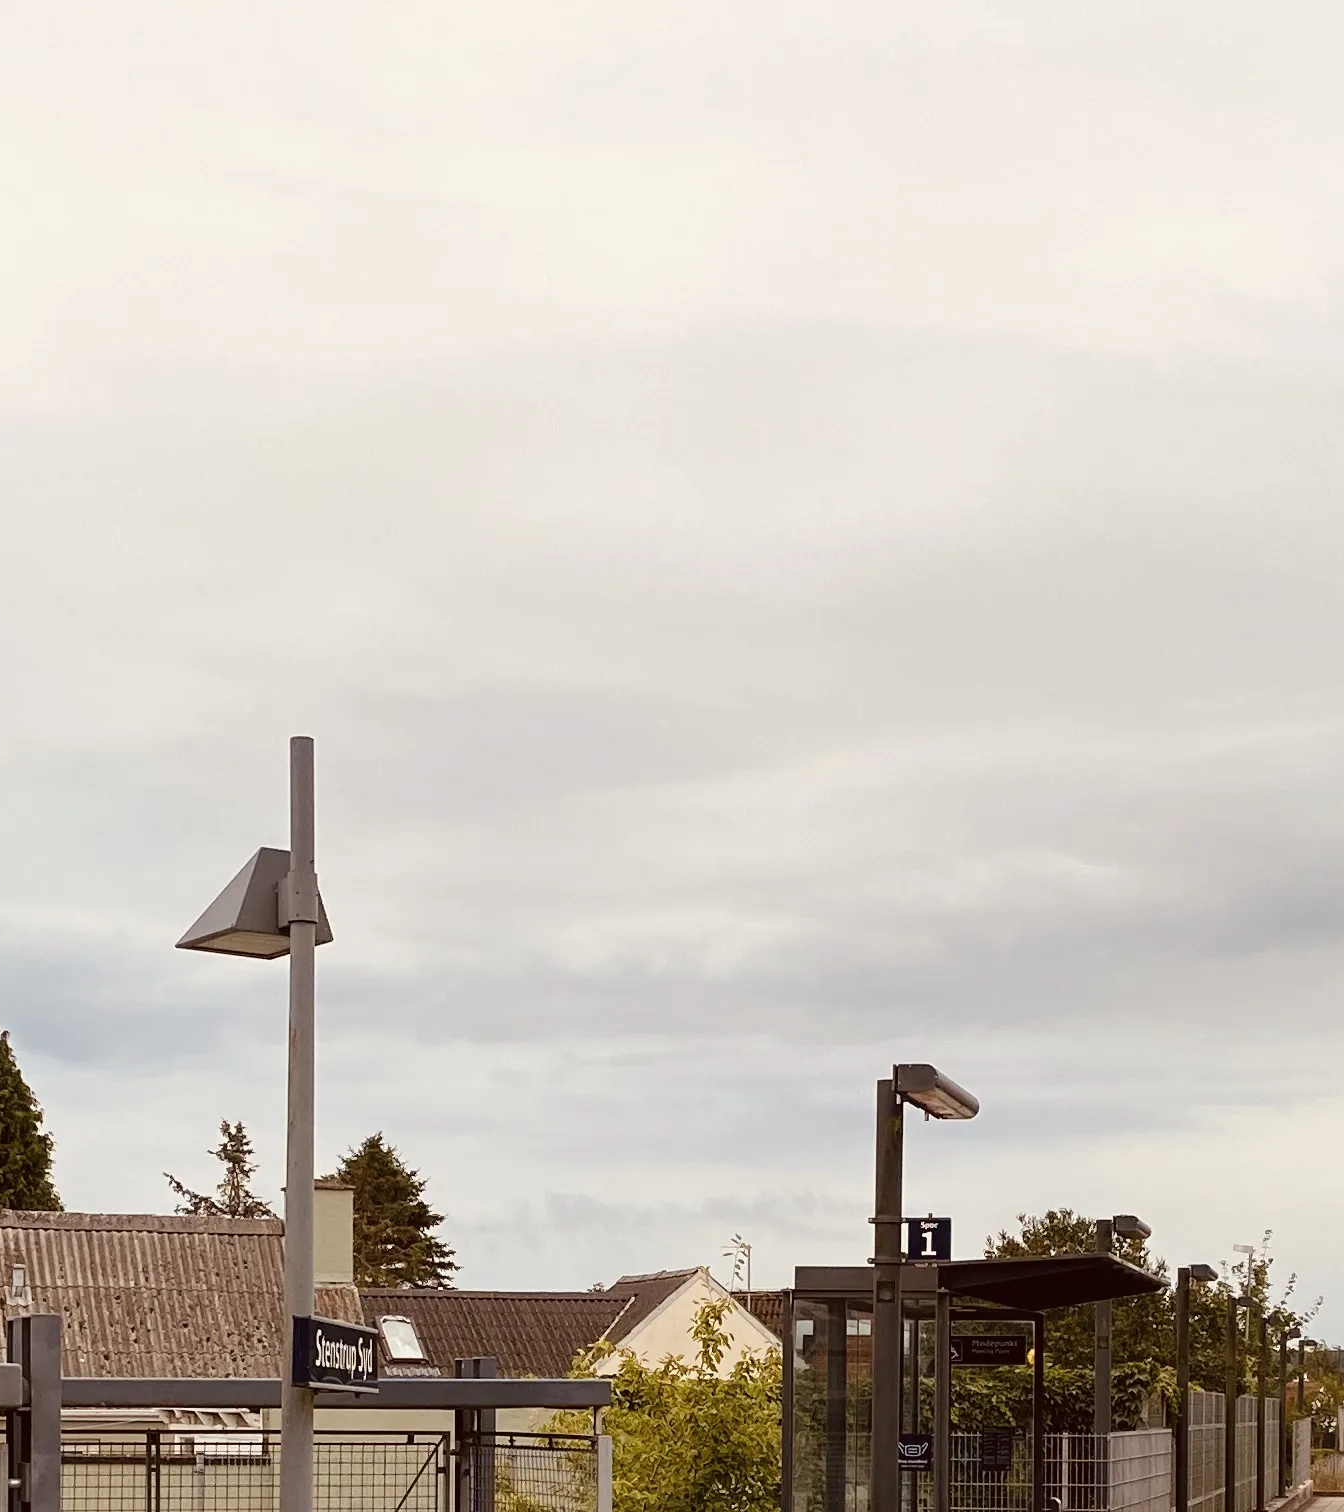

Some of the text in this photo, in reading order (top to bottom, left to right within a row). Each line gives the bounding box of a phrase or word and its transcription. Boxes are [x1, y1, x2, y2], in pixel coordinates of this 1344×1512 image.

[920, 1221, 938, 1230] Spor
[921, 1231, 936, 1256] 1
[315, 1329, 373, 1382] Stenstrup Syd
